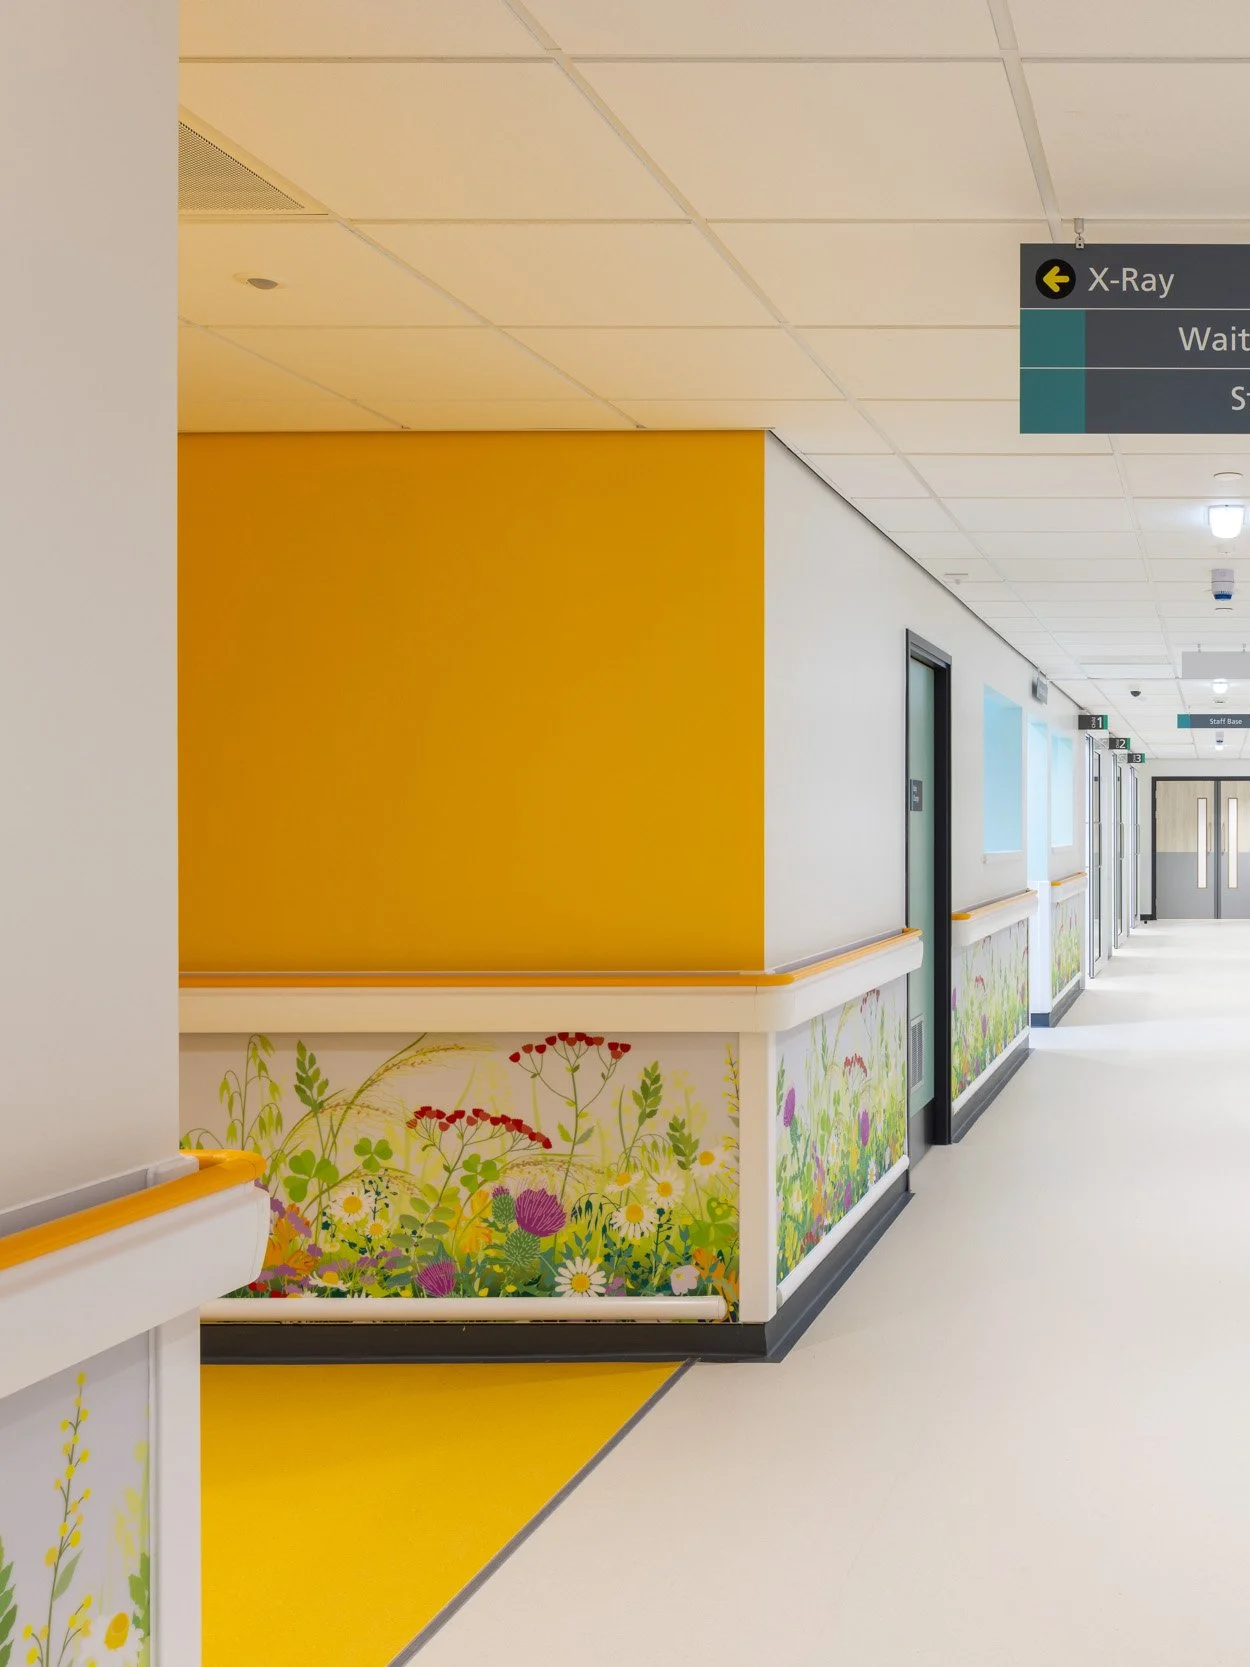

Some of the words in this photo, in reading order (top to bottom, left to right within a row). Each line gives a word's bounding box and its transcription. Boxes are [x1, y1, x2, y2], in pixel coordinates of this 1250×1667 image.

[1088, 267, 1175, 298] X-Ray
[1097, 716, 1102, 728] 1
[1119, 739, 1126, 749] 2
[1135, 754, 1142, 763] 3
